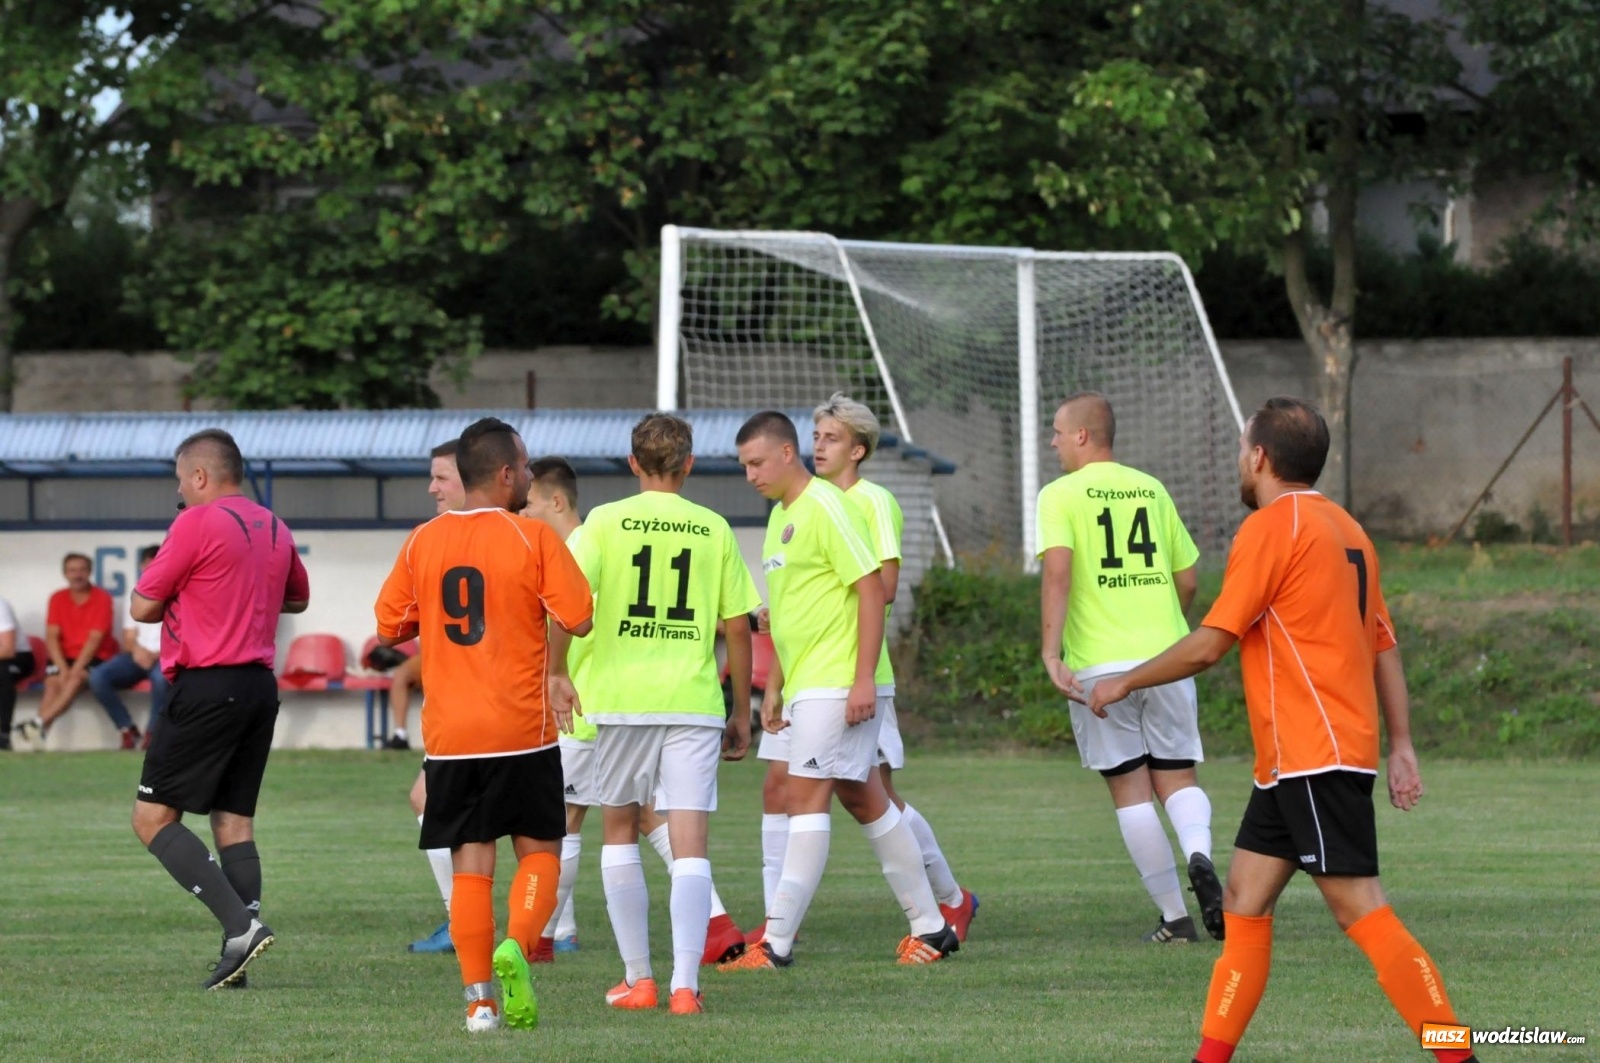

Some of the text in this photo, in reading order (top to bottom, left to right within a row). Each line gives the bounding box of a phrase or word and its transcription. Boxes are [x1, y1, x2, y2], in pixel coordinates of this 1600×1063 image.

[1087, 487, 1156, 501] Czyżowice
[621, 518, 710, 536] Czyżowice
[1097, 507, 1157, 569] 14
[628, 545, 695, 621] 11
[1098, 574, 1161, 588] Pati Trans
[442, 566, 485, 646] 9
[618, 620, 694, 640] Pati Trans
